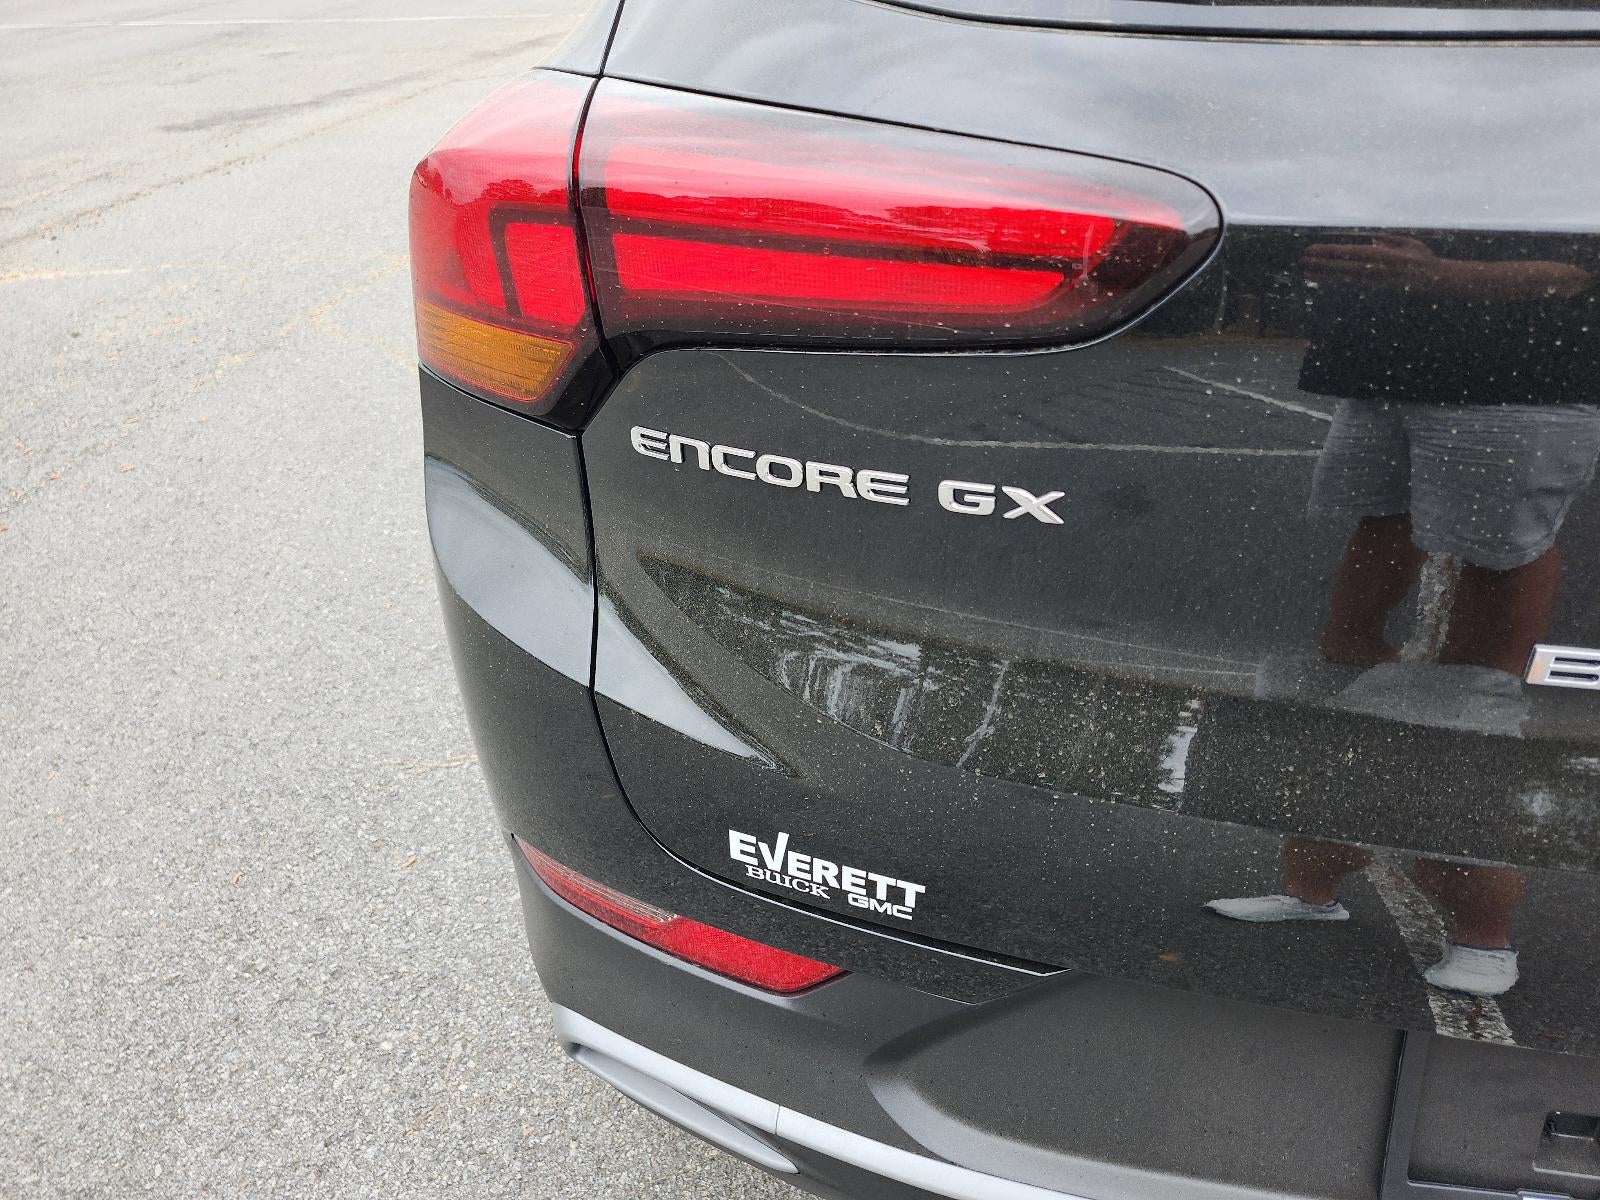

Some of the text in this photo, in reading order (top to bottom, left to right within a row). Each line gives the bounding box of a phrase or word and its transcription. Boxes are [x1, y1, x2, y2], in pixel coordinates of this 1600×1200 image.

[630, 425, 1066, 525] ENCORE GX
[728, 829, 926, 909] EVERETT
[745, 864, 913, 920] BUICK GMC
